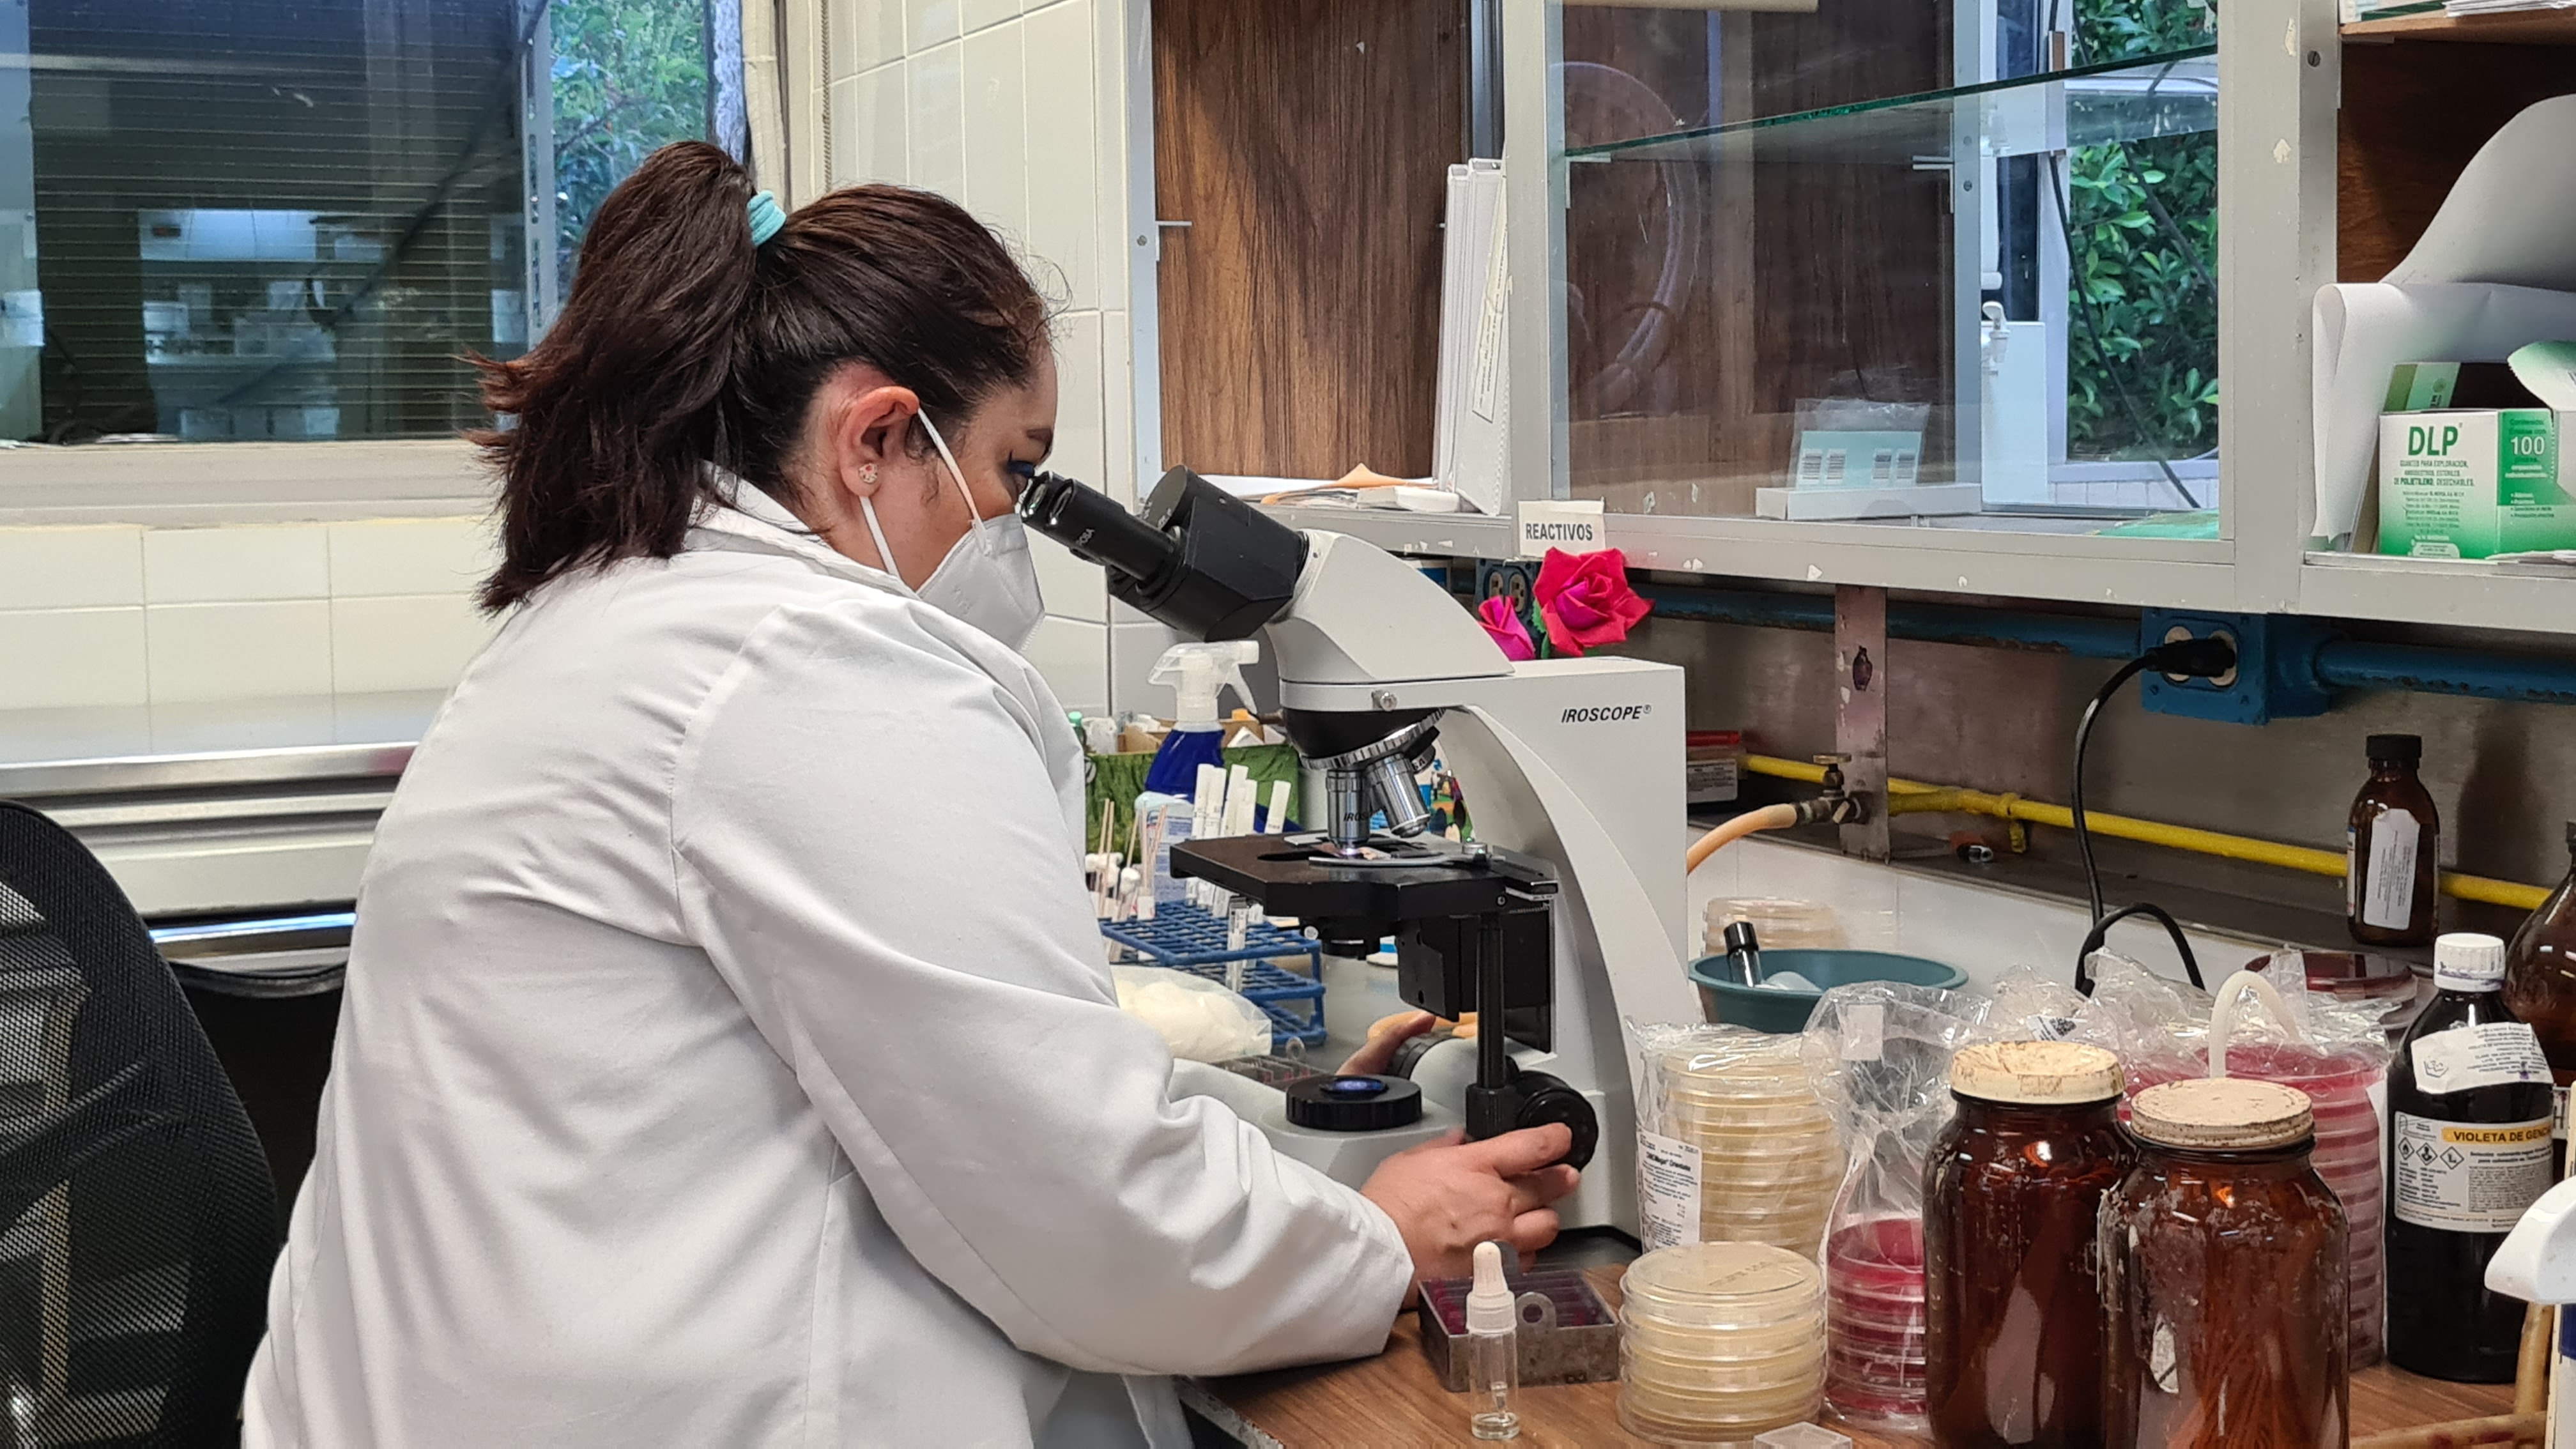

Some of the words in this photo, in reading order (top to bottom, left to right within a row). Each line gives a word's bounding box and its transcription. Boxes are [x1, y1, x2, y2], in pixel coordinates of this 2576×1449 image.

[2408, 425, 2458, 456] DLP
[2510, 436, 2545, 455] 100
[1526, 523, 1593, 541] REACTIVOS
[2453, 1131, 2506, 1142] VIOLETA
[2510, 1130, 2523, 1142] DE
